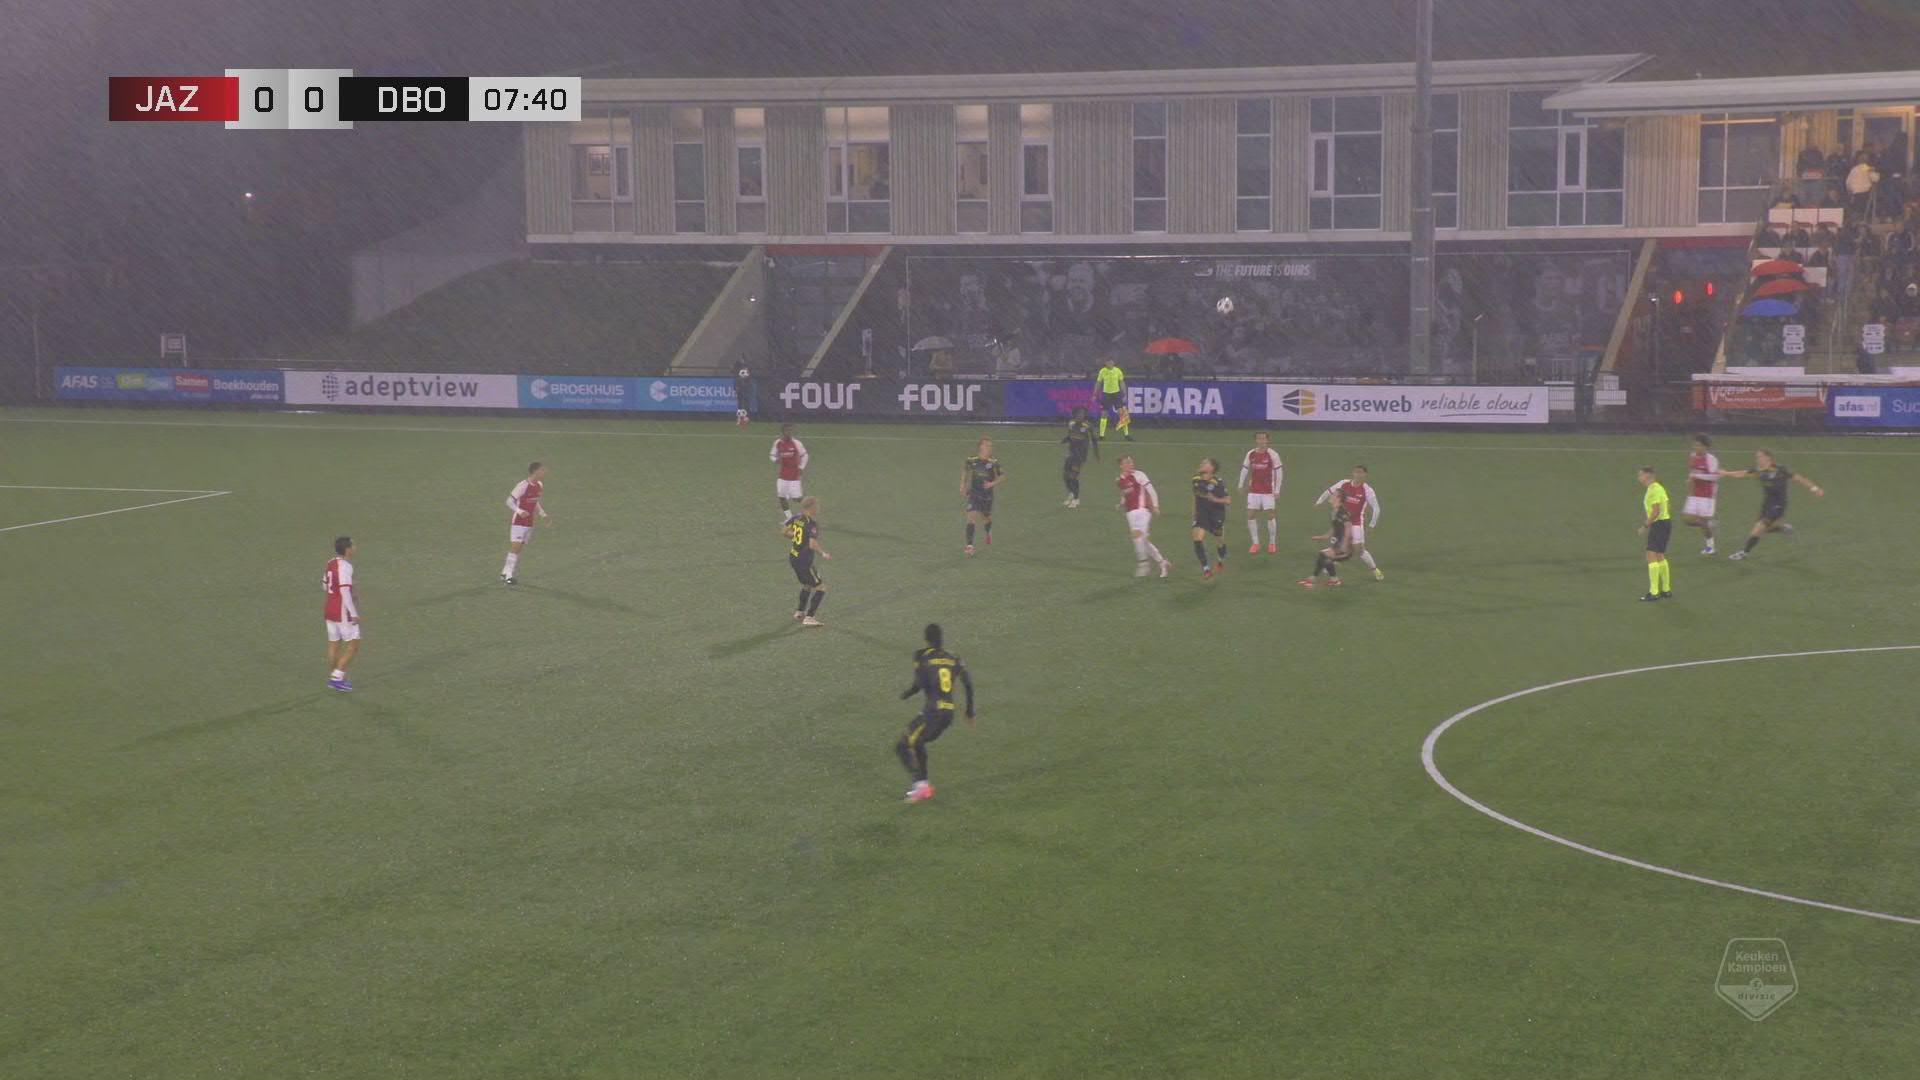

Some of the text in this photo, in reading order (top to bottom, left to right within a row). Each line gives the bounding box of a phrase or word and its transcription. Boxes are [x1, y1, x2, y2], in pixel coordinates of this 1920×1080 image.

[1215, 263, 1312, 277] THE FUTURE IS OURS
[61, 375, 98, 389] AFAS
[213, 378, 280, 392] Boekhouden
[345, 375, 480, 401] adeptview
[550, 383, 625, 396] BROEKHUIS
[779, 382, 861, 410] four
[897, 384, 982, 412] four
[1126, 387, 1225, 415] EBARA
[1324, 393, 1532, 413] leaseweb reliable cloud
[938, 667, 952, 693] 8
